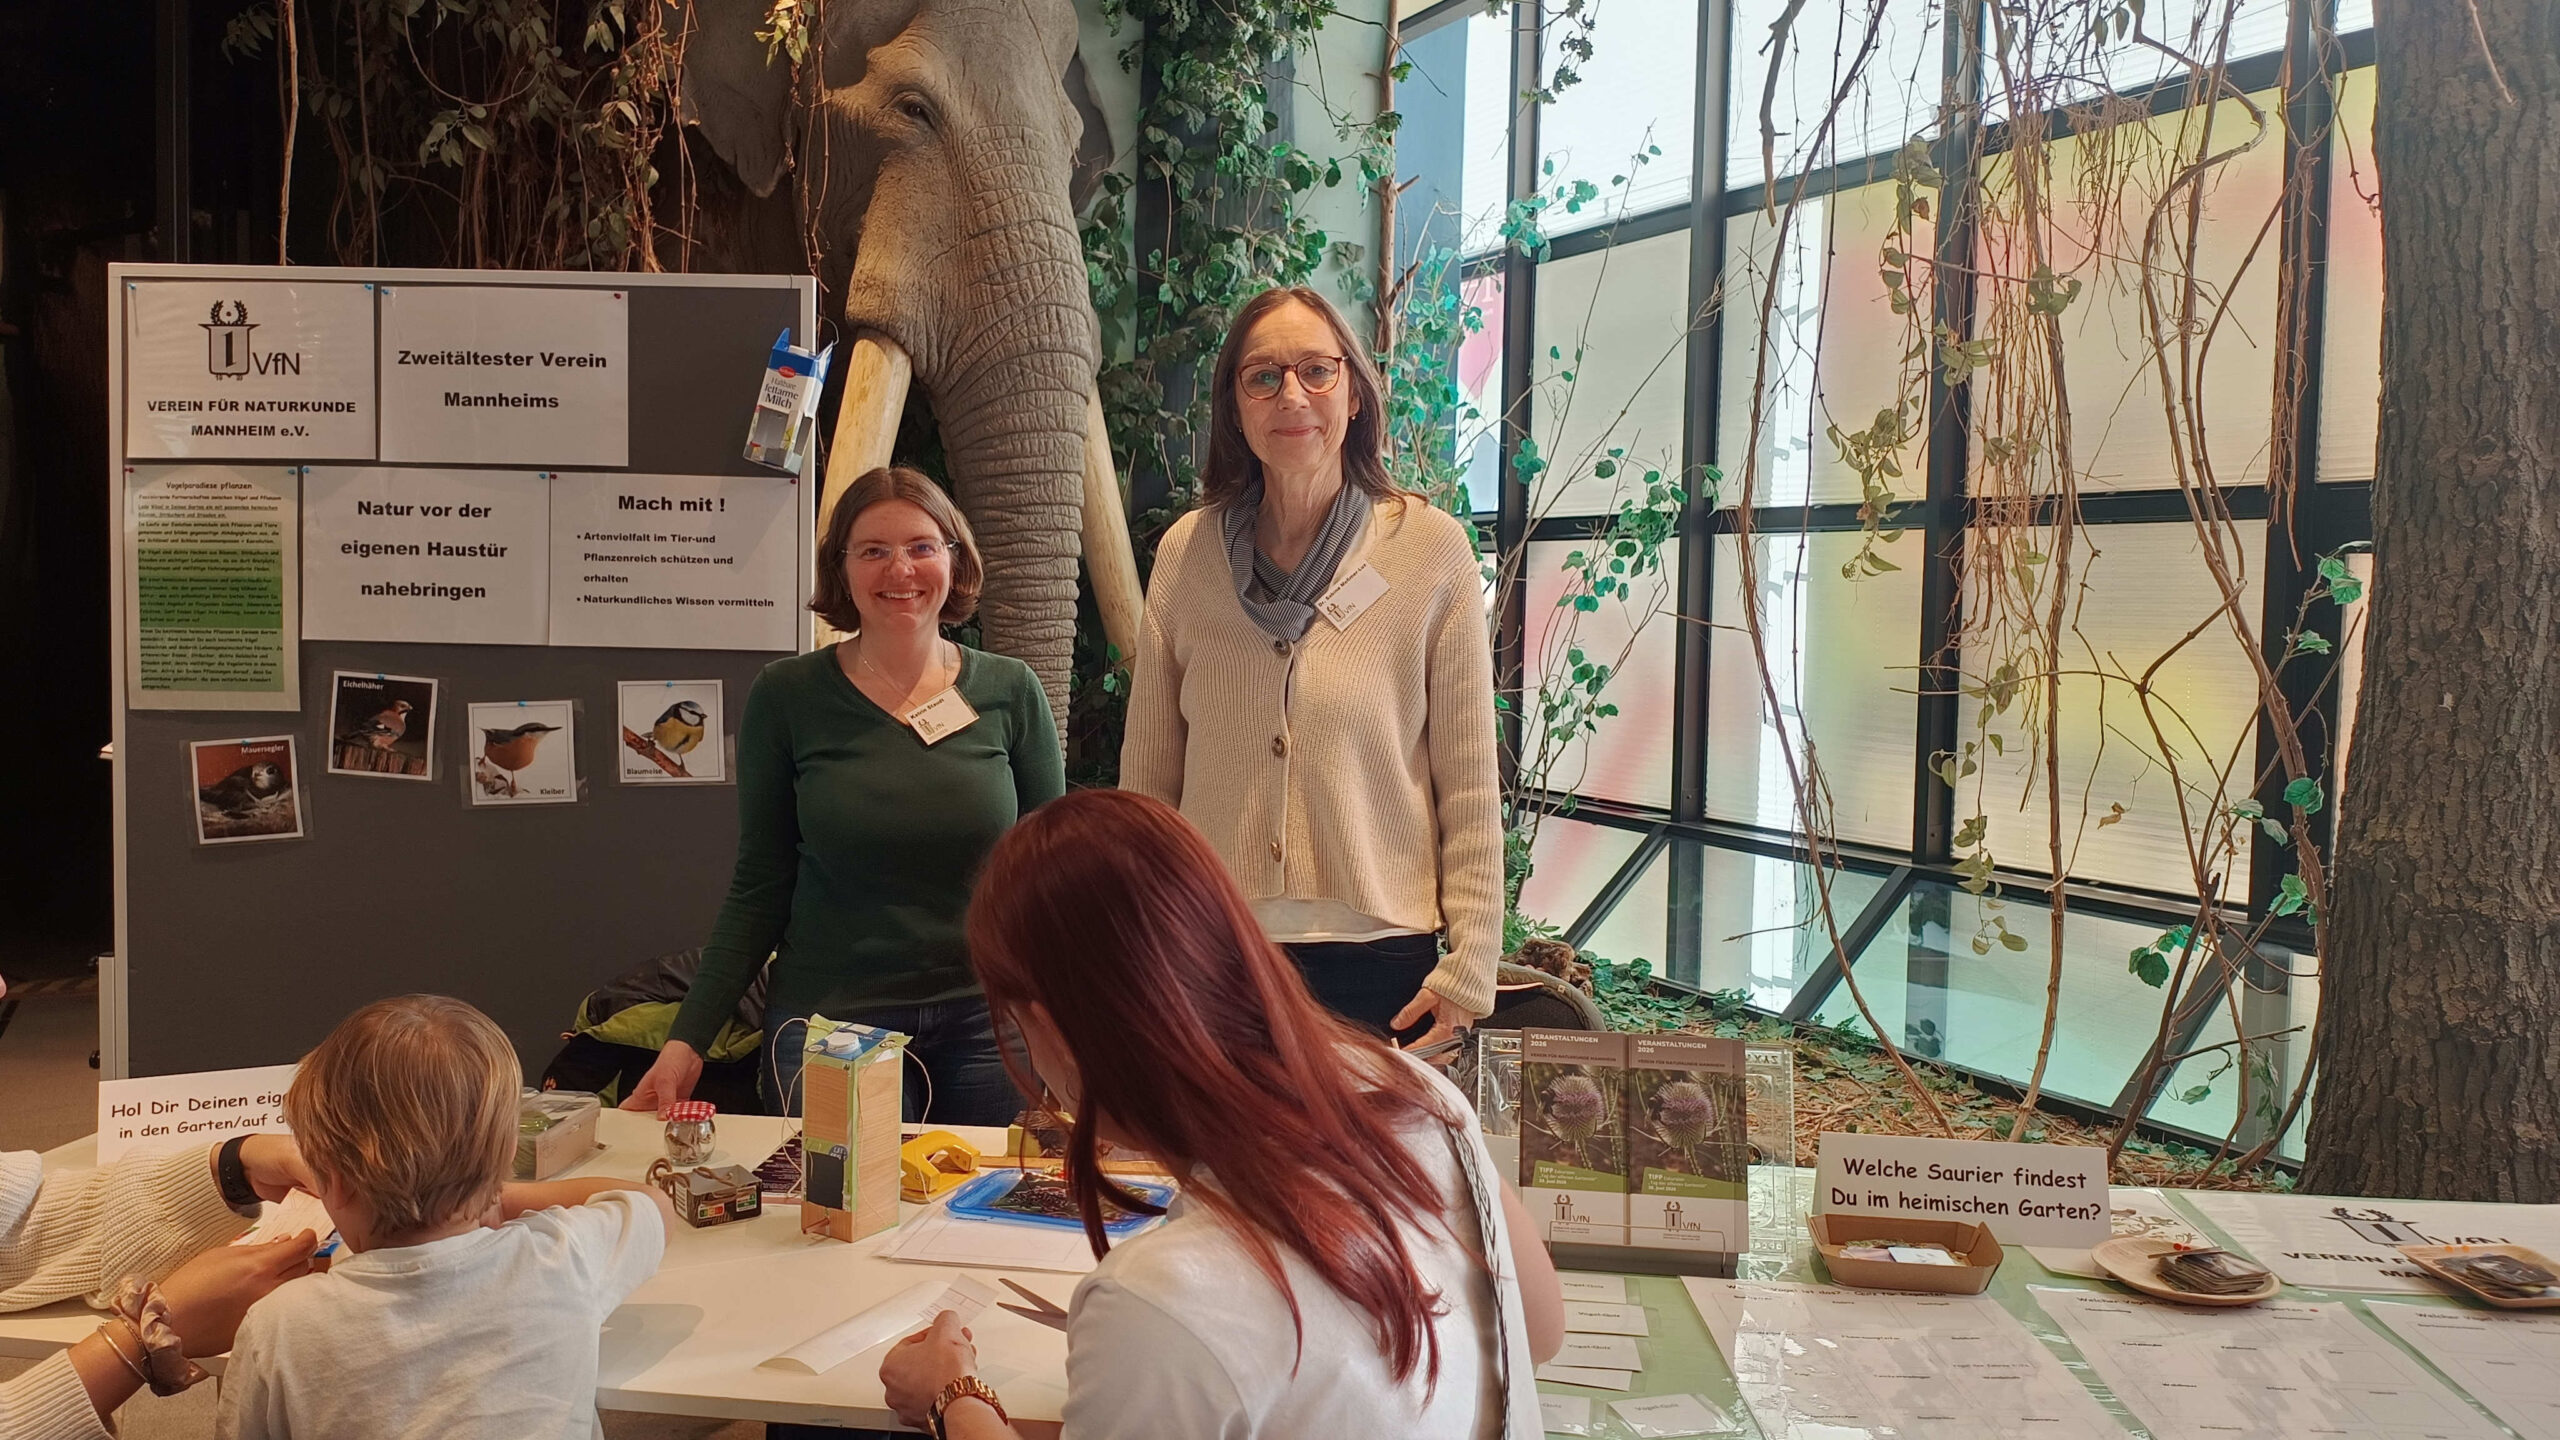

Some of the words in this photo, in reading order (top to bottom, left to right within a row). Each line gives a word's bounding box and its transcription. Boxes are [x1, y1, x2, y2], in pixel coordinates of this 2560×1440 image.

[252, 352, 301, 375] VfN
[398, 349, 533, 368] Zweitältester
[539, 351, 607, 368] Verein
[764, 384, 799, 401] fettarme
[147, 400, 203, 412] VEREIN
[208, 398, 240, 412] FÜR
[245, 400, 357, 413] NATURKUNDE
[444, 391, 559, 409] Mannheims
[765, 393, 793, 410] Milch
[191, 425, 276, 437] MANNHEIM
[280, 425, 309, 437] e.V.
[166, 482, 217, 491] Vogelparadiese
[220, 482, 253, 491] pflanzen
[357, 500, 414, 518] Natur
[420, 503, 452, 518] vor
[458, 502, 492, 518] der
[618, 494, 673, 512] Mach
[680, 495, 713, 512] mit
[719, 497, 726, 512] !
[584, 531, 651, 543] Artenvielfalt
[653, 533, 667, 543] im
[670, 533, 716, 545] Tier-und
[341, 542, 420, 560] eigenen
[427, 541, 508, 559] Haustür
[584, 552, 657, 564] Pflanzenreich
[660, 553, 710, 565] schützen
[713, 555, 734, 565] und
[584, 573, 629, 584] erhalten
[361, 580, 486, 602] nahebringen
[583, 594, 672, 605] Naturkundliches
[675, 596, 715, 607] Wissen
[718, 597, 774, 608] vermitteln
[342, 680, 385, 691] Eichelhäher
[240, 743, 285, 755] Mauersegler
[626, 767, 663, 777] Blaumeise
[540, 787, 565, 796] Kleiber
[1531, 1033, 1599, 1043] VERANSTALTUNGEN
[1637, 1039, 1707, 1049] VERANSTALTUNGEN
[111, 1102, 142, 1118] Hol
[151, 1099, 179, 1115] Dir
[188, 1096, 248, 1112] Deinen
[256, 1091, 288, 1108] eig
[119, 1127, 133, 1139] in
[141, 1124, 170, 1137] den
[177, 1112, 268, 1135] Garten/auf
[1843, 1157, 1918, 1179] Welche
[1927, 1164, 2003, 1184] Saurier
[2014, 1167, 2087, 1189] findest
[1831, 1187, 1857, 1206] Du
[1867, 1190, 1889, 1208] im
[1899, 1191, 2009, 1215] heimischen
[2018, 1199, 2102, 1221] Garten?
[2281, 1252, 2383, 1264] VEREIN
[2378, 1269, 2442, 1280] MAN
[2077, 1296, 2120, 1305] Welcher
[1634, 1402, 1679, 1411] Vogel-Quiz
